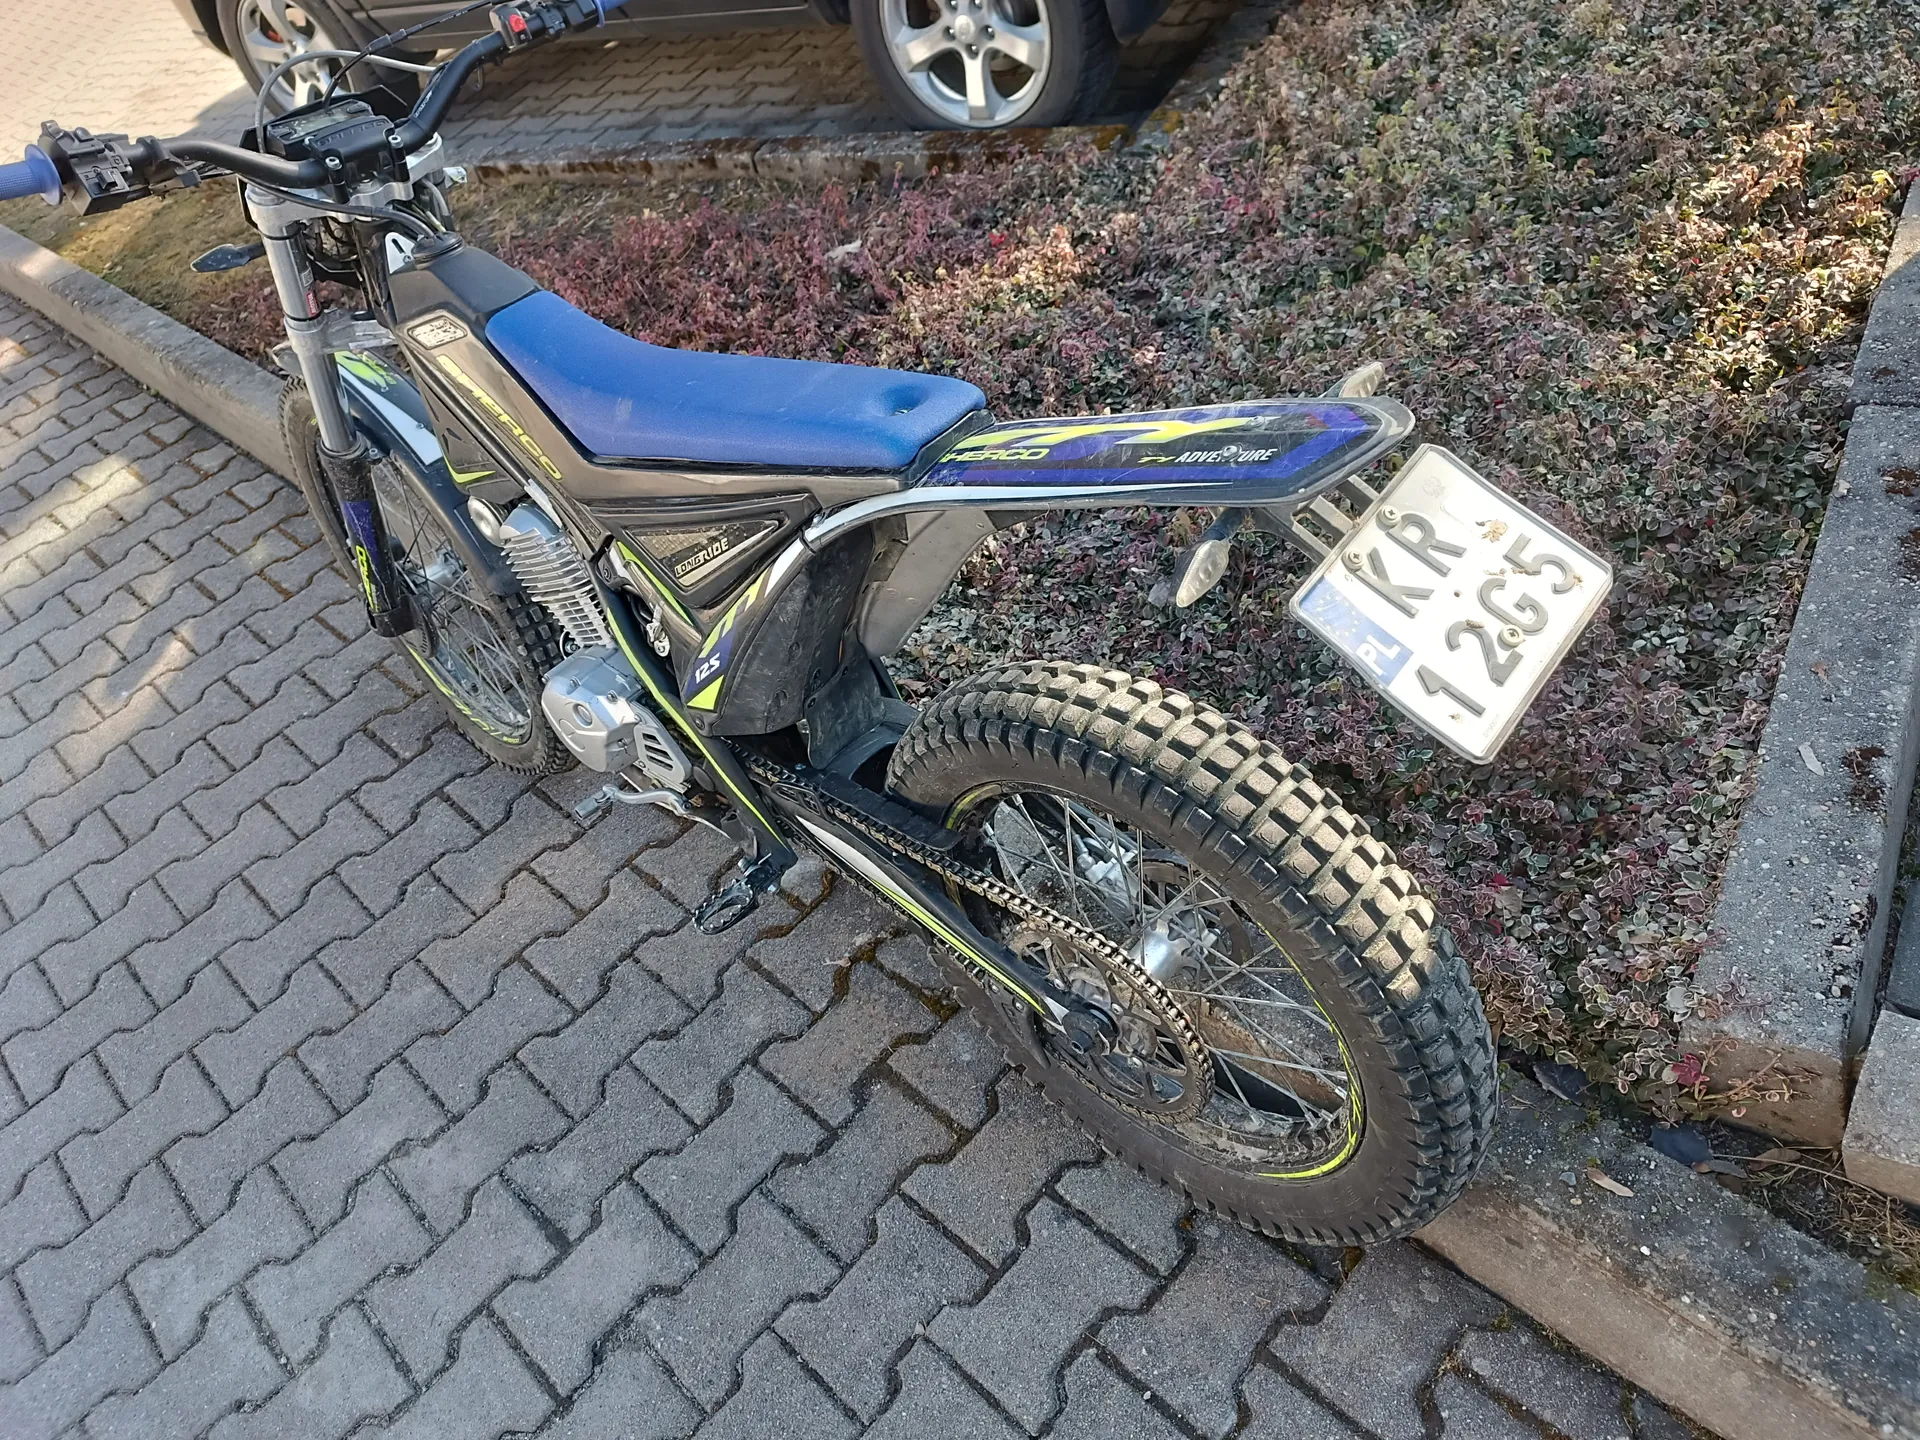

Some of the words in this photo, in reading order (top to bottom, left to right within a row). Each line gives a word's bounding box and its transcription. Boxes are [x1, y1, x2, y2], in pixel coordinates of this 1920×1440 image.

[1174, 448, 1278, 463] ADVEURE
[1353, 512, 1467, 619] KR
[1355, 634, 1401, 676] PL
[1415, 533, 1576, 718] 12G5
